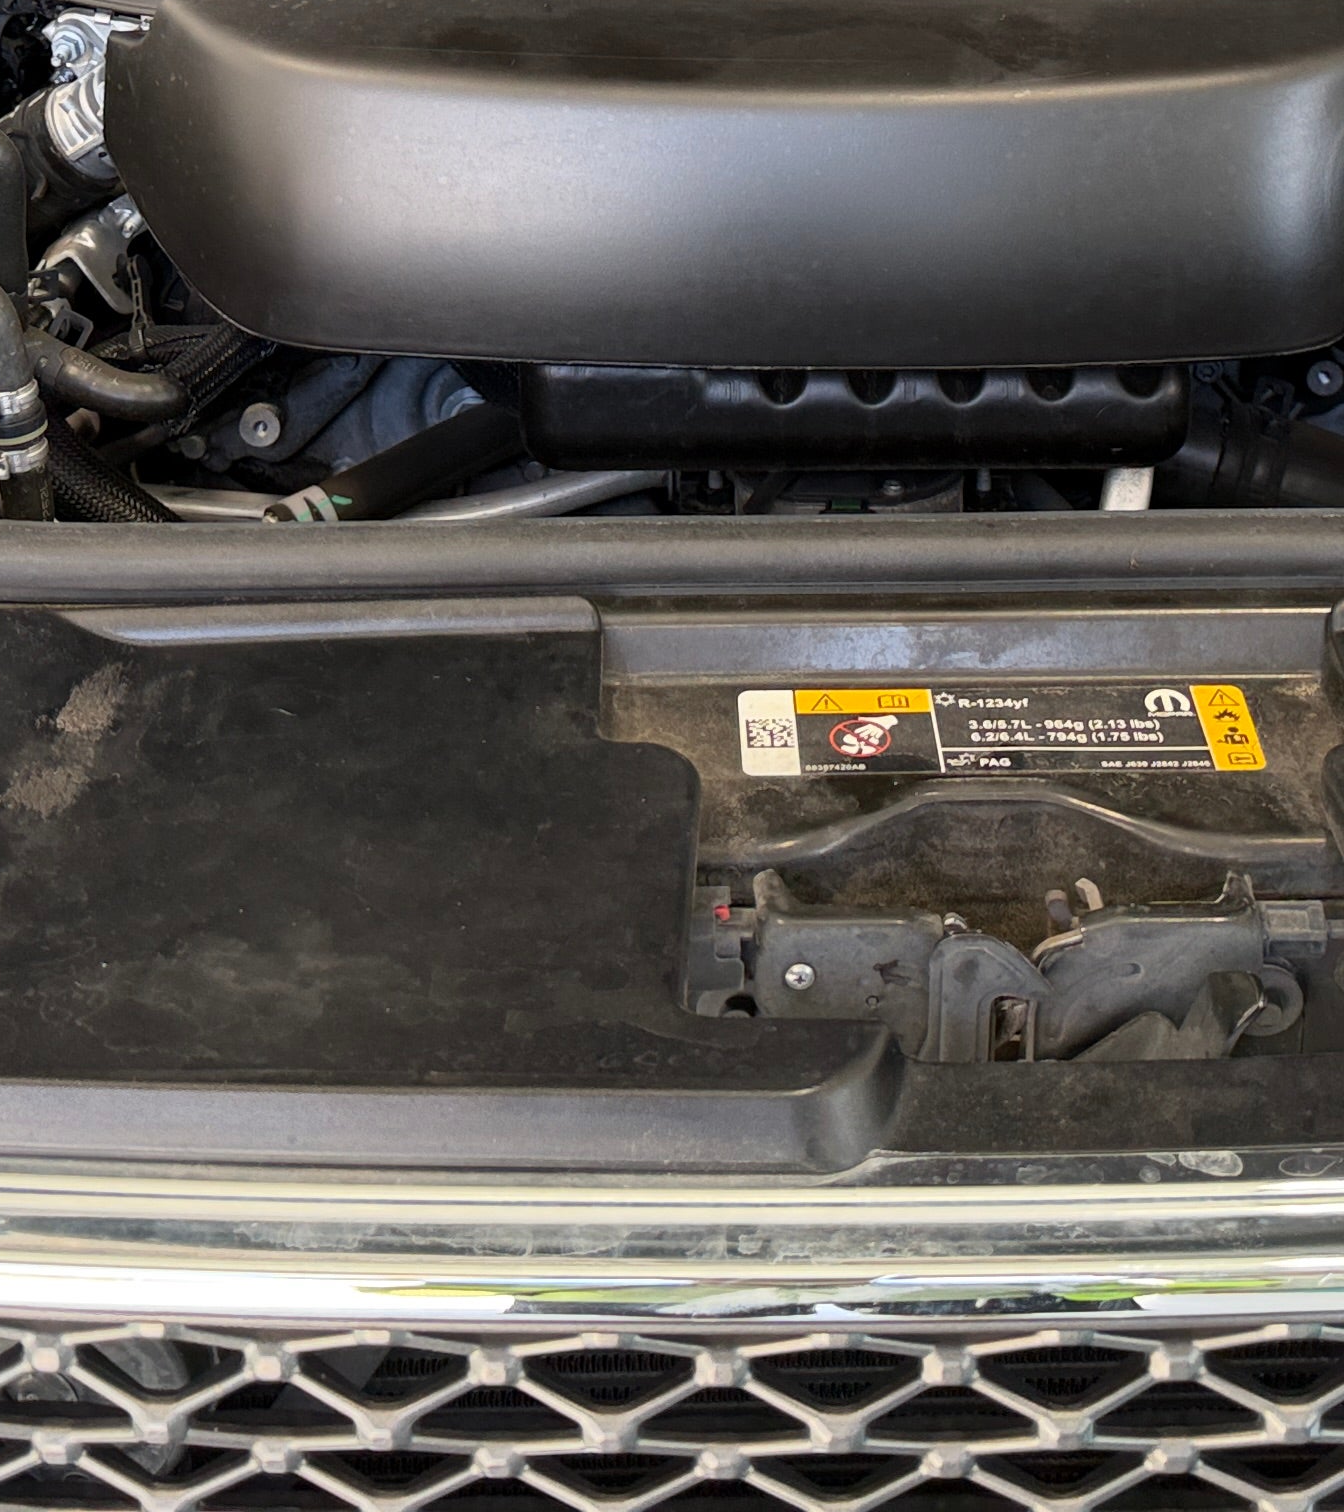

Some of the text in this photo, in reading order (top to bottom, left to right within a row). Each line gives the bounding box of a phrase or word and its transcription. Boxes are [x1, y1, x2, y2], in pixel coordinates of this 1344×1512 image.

[958, 698, 1029, 709] R-1234yf
[968, 719, 1032, 730] 3.6/5.7L
[1088, 719, 1127, 731] (2.13
[1130, 719, 1161, 730] lbs)
[970, 731, 1035, 742] 6.2/6.4L
[1091, 731, 1131, 743] (1.75
[1134, 731, 1164, 743] lbs)
[979, 757, 1012, 767] PAG
[1101, 760, 1123, 768] SAE
